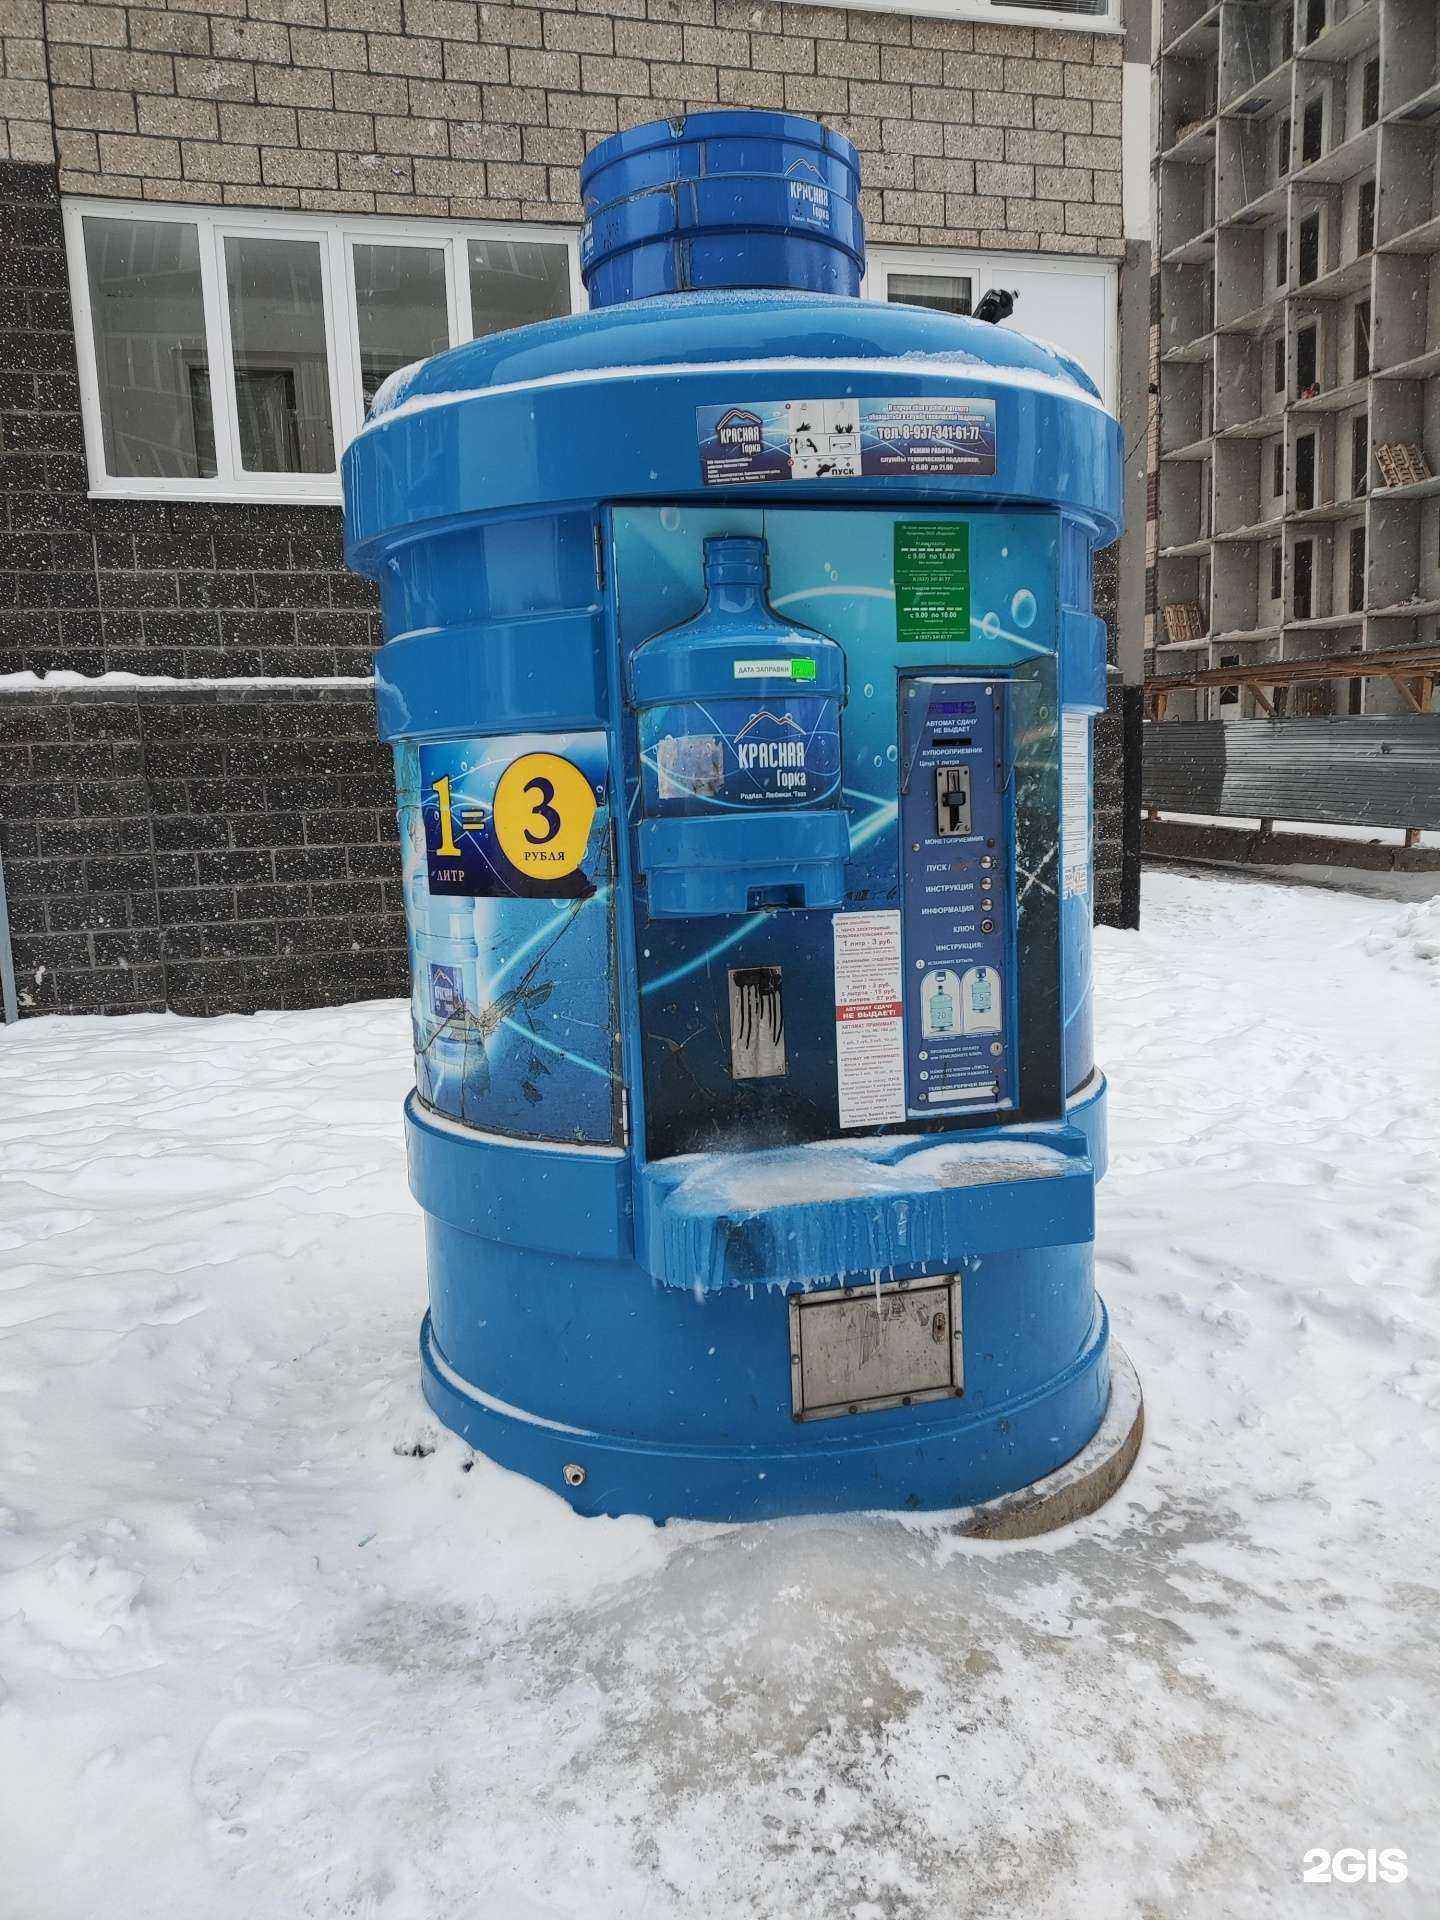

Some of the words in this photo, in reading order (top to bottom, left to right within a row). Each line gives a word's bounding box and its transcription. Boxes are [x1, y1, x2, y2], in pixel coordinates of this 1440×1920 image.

[903, 424, 979, 440] 8-937-341-61-77
[738, 666, 755, 674] ДАТА
[738, 741, 805, 769] КРАСНАЯ
[777, 769, 807, 790] Горка
[523, 776, 561, 844] 3
[524, 850, 565, 862] РУБЛЯ
[926, 864, 947, 872] ПУСК
[436, 869, 465, 883] ЛИТР
[925, 883, 974, 893] ИНСТРУКЦИЯ
[921, 905, 974, 915] ИНФОРМАЦИЯ
[953, 925, 975, 933] КЛЮЧ
[857, 1009, 896, 1018] ВЫДАЕТ!
